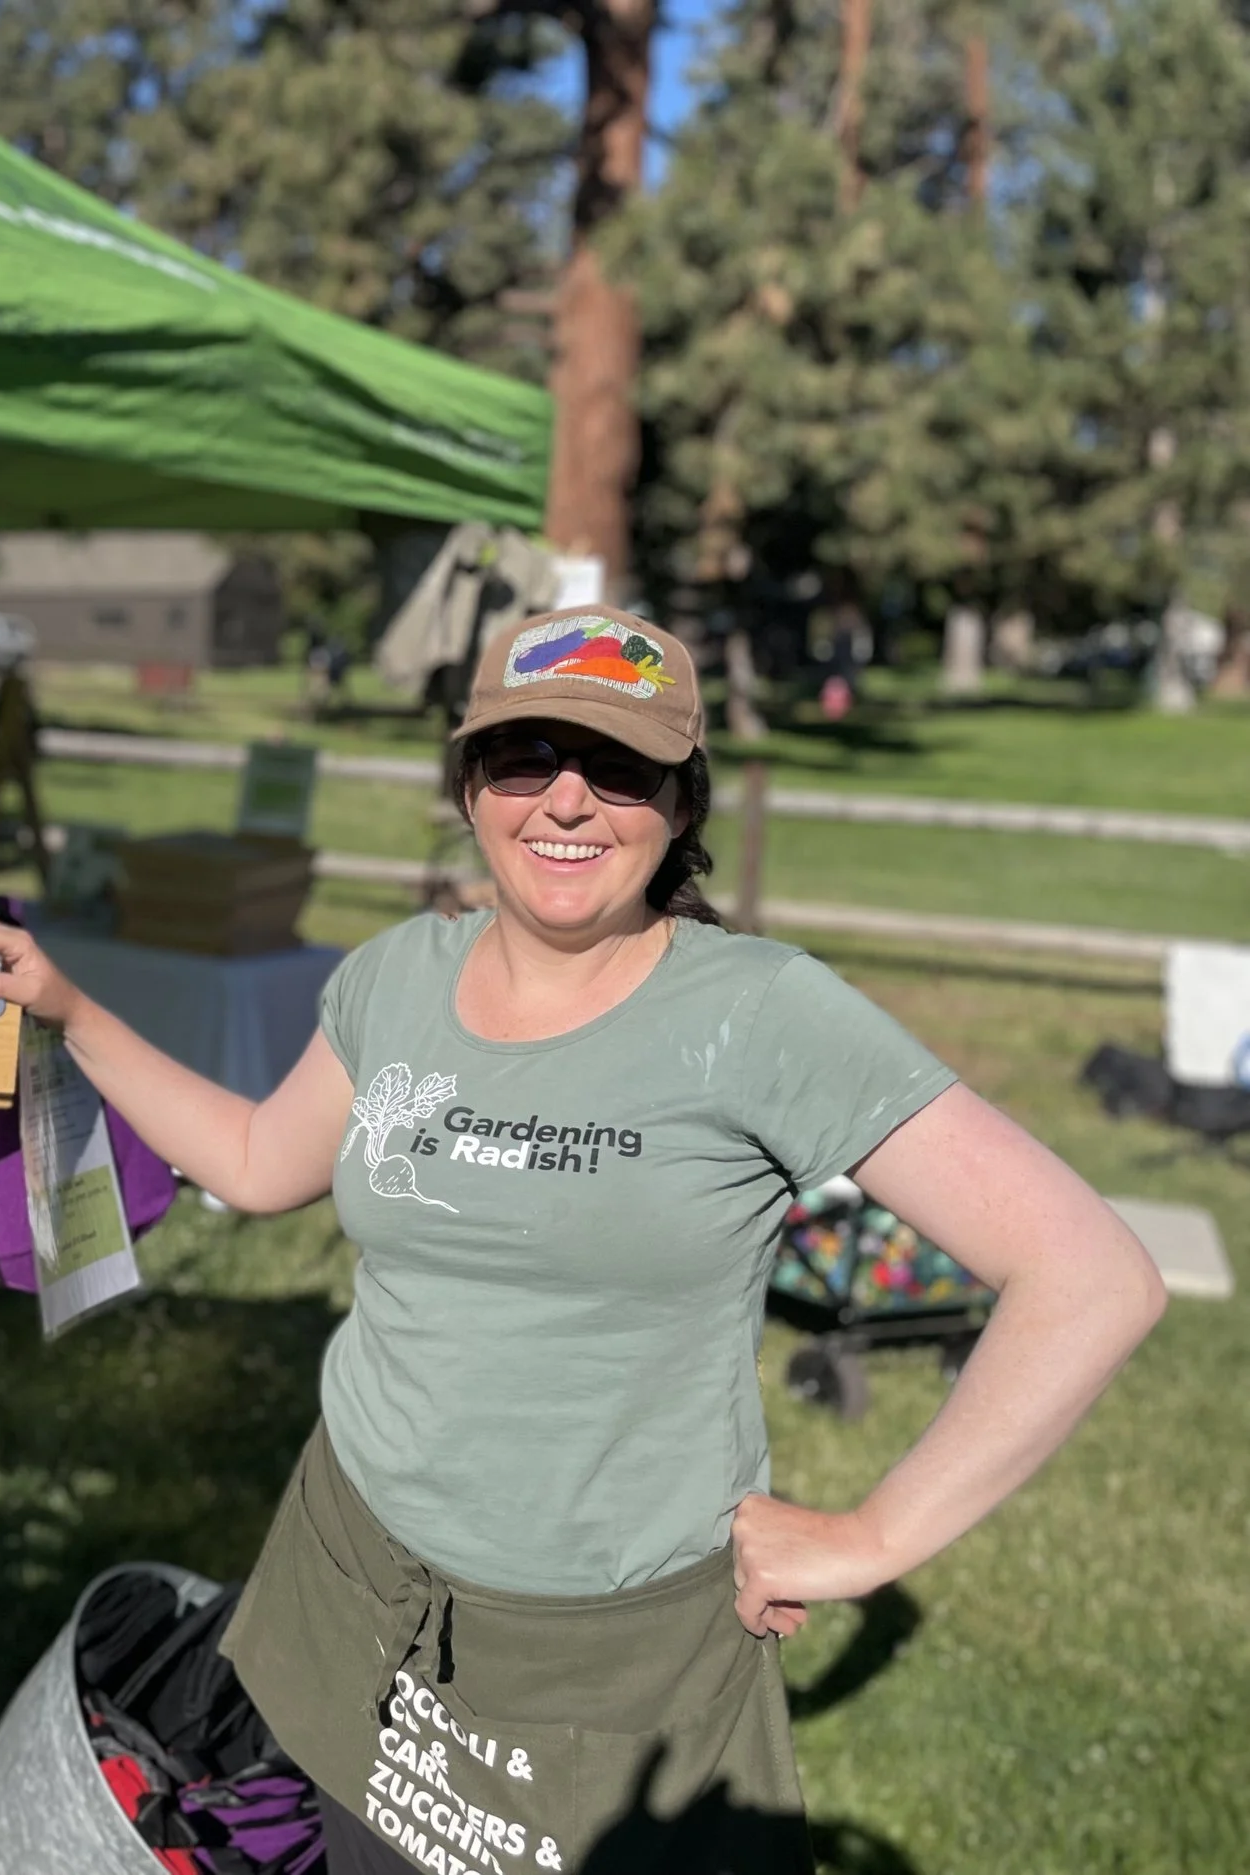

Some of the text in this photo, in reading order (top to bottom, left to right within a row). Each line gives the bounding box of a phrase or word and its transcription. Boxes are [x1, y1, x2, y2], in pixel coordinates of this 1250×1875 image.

[409, 1128, 600, 1174] is Radish!
[442, 1106, 643, 1157] Gardening
[506, 1747, 533, 1781] &
